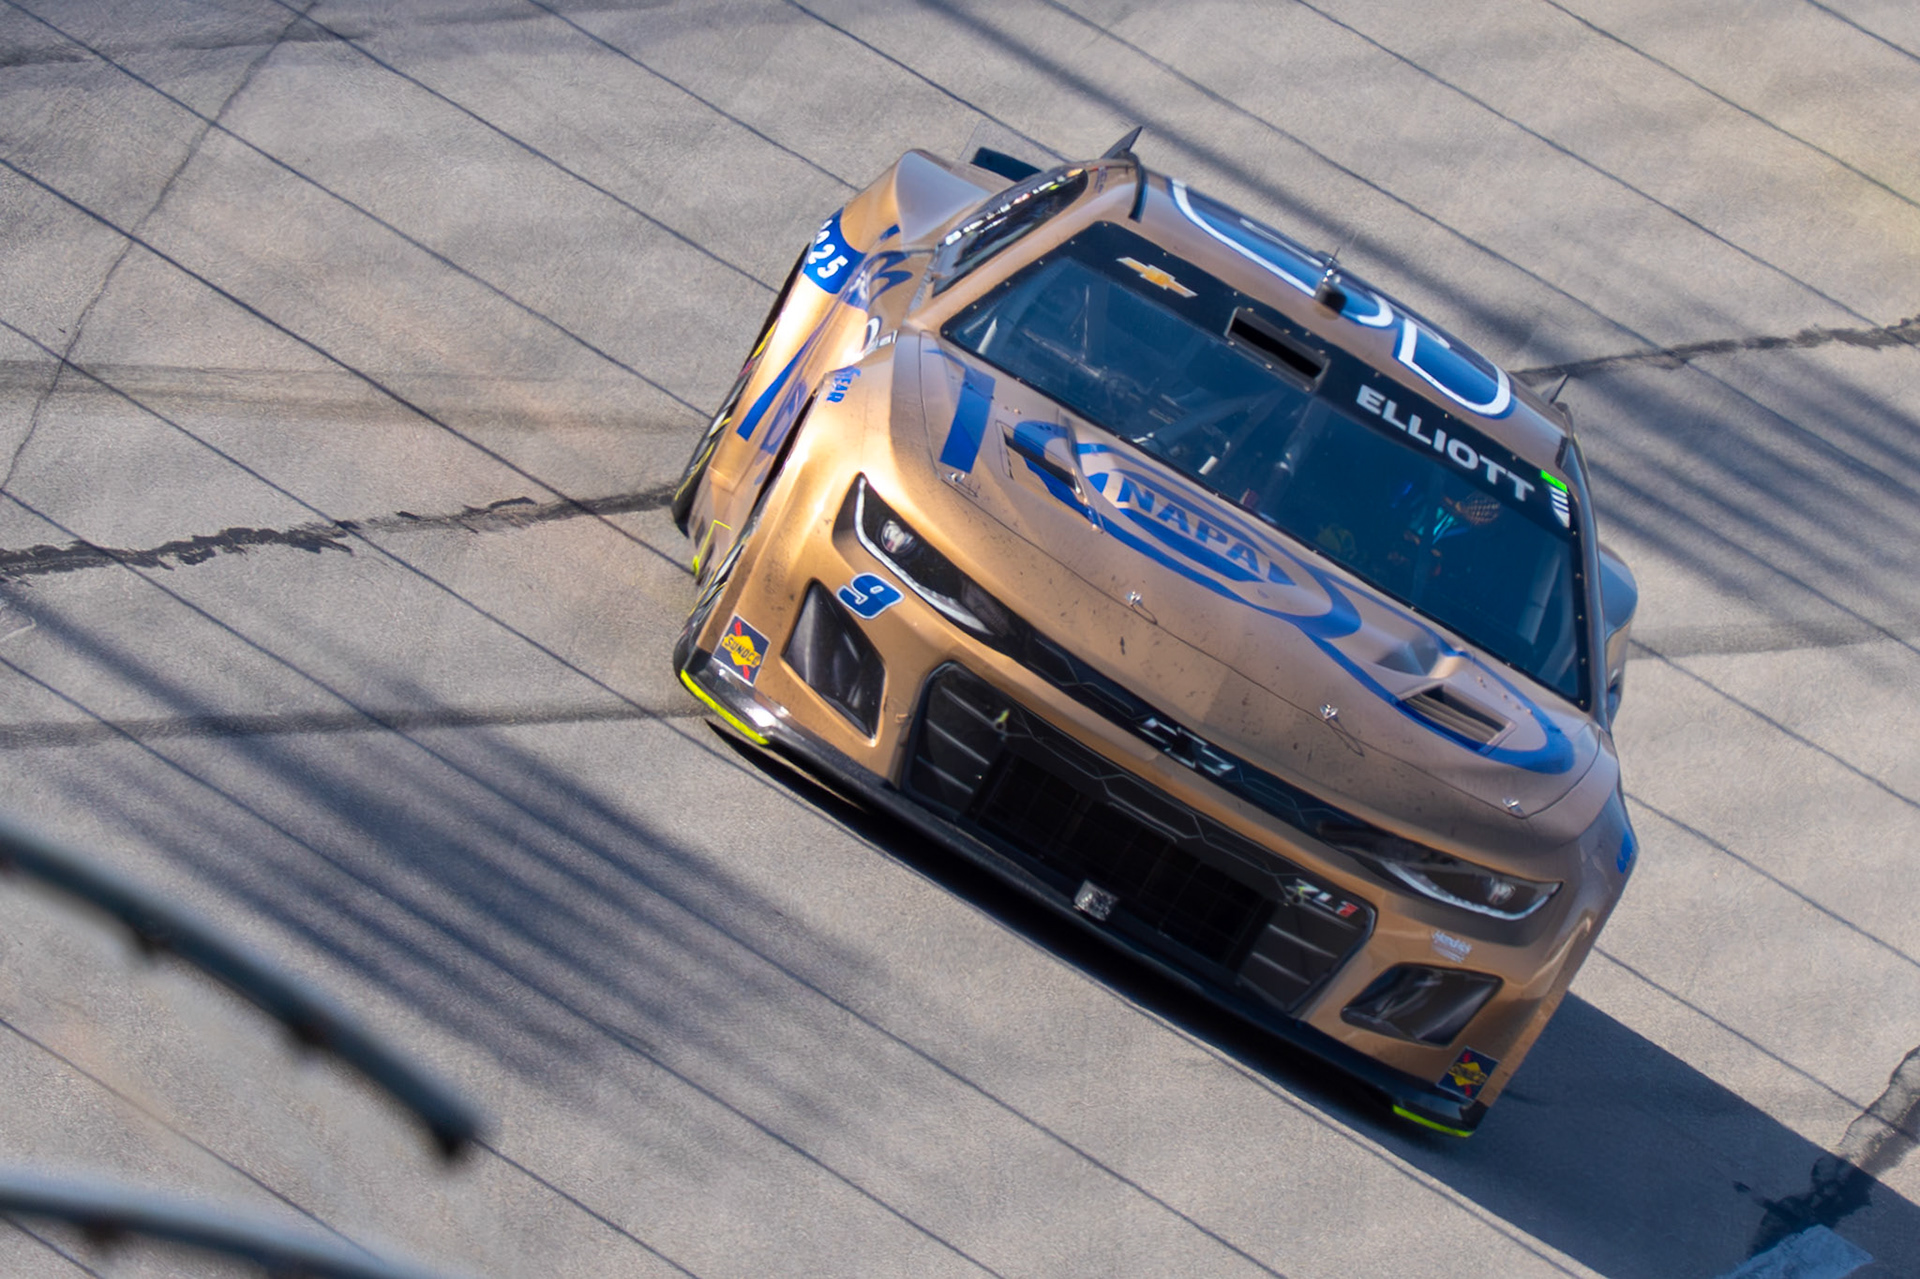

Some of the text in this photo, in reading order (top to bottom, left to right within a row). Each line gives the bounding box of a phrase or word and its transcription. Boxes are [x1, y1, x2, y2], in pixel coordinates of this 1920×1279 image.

[1356, 384, 1535, 502] ELLIOTT
[1116, 477, 1260, 574] NAPA
[836, 572, 905, 620] 9
[722, 635, 761, 667] SUNOCO
